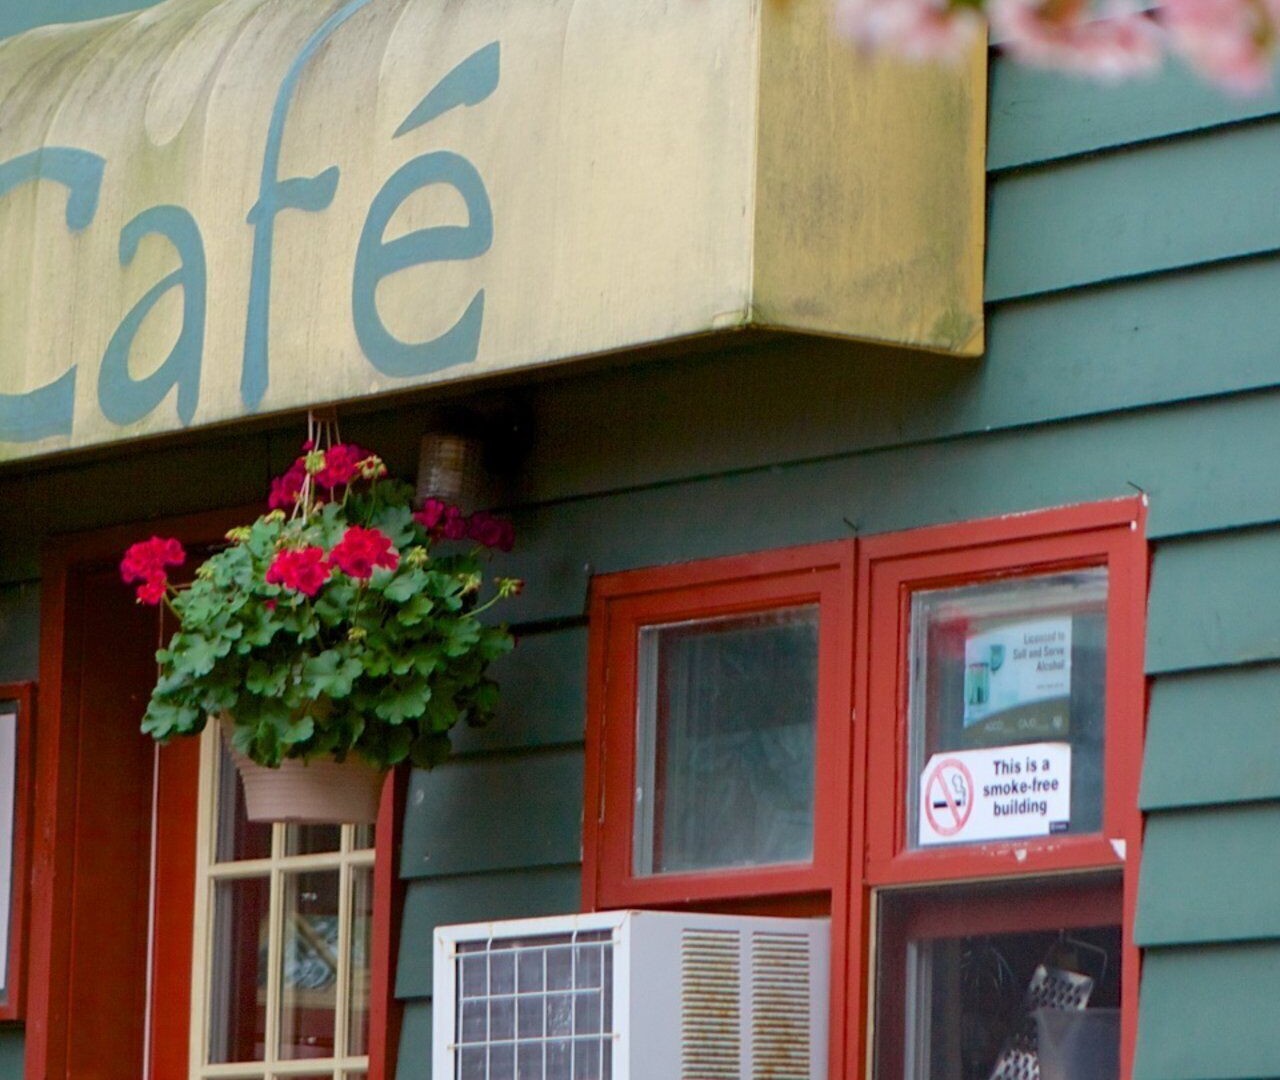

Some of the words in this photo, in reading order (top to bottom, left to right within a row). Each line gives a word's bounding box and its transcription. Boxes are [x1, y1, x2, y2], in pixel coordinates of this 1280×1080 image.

[993, 758, 1021, 775] This
[1026, 756, 1037, 772] is
[1042, 759, 1050, 771] a
[983, 777, 1059, 797] smoke-free
[993, 798, 1047, 817] building
